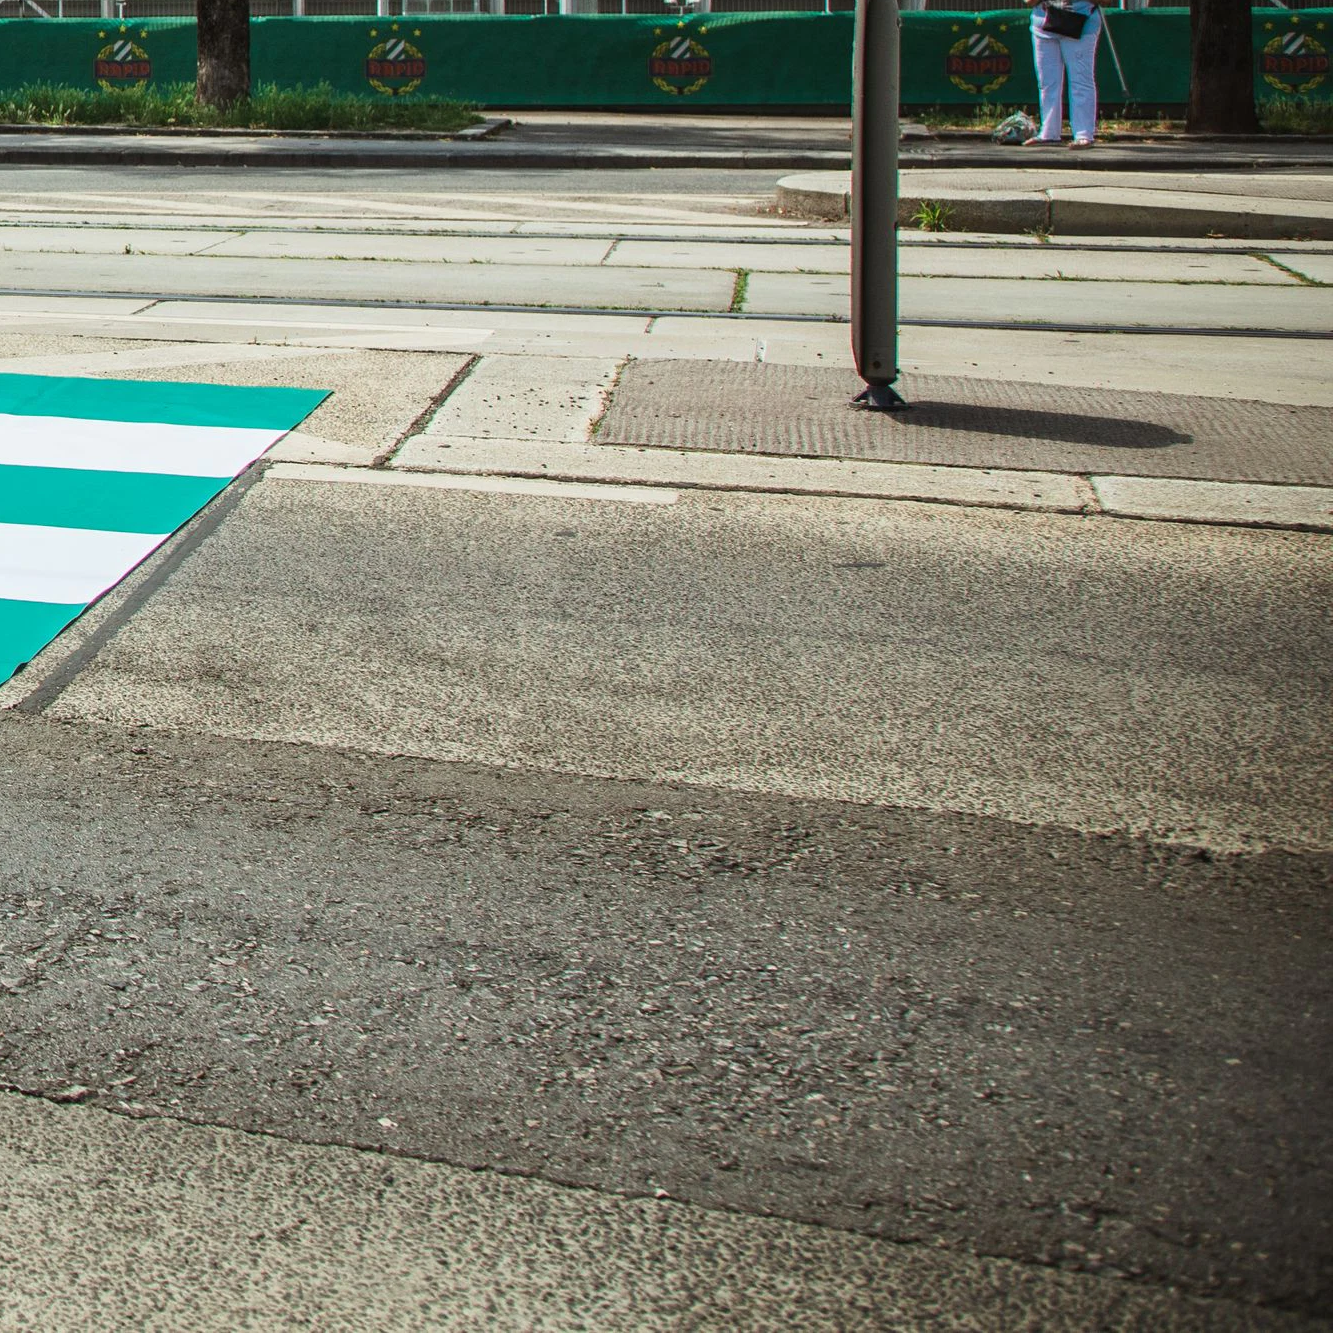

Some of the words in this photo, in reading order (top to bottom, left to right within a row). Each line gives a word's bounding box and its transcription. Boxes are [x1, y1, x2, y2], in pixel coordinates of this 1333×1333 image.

[368, 60, 425, 77] RAPID
[652, 58, 711, 75] RAPID
[950, 57, 1012, 74] RAPID
